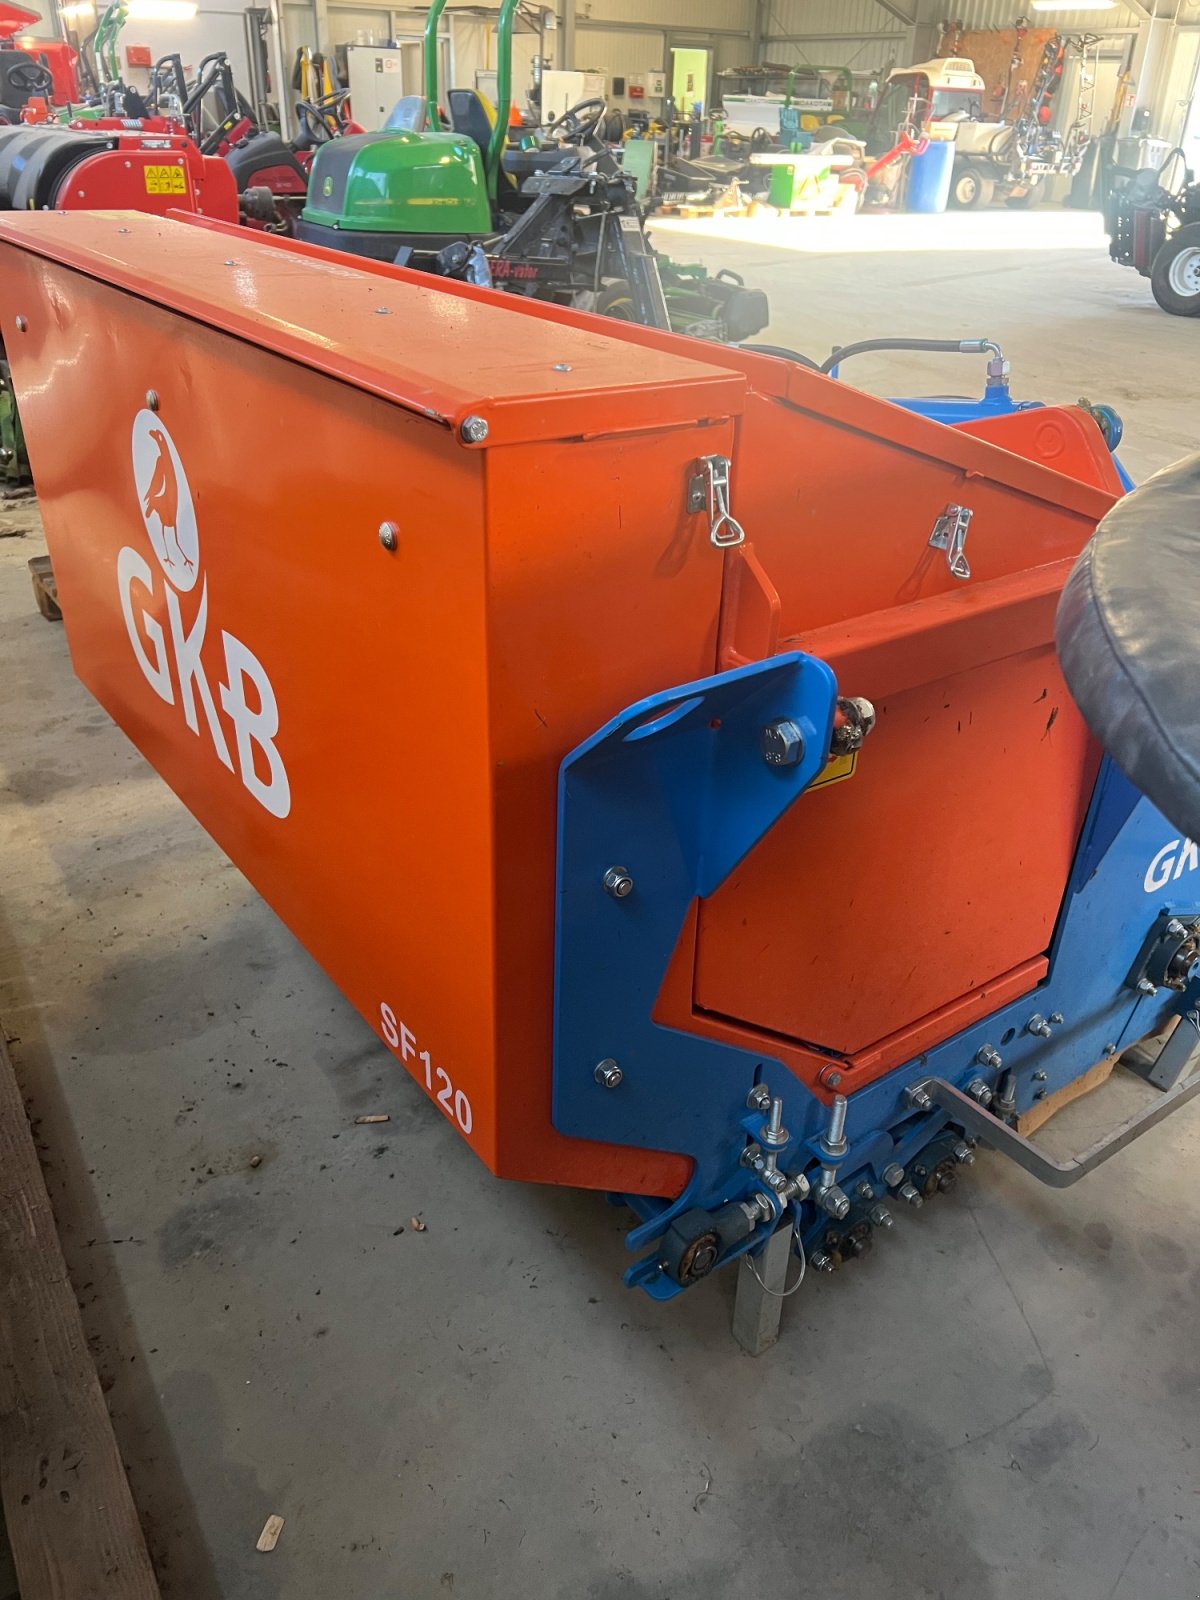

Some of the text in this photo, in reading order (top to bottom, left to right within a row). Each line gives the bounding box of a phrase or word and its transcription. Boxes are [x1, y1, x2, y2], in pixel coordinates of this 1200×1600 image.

[491, 260, 538, 279] ERA-vator
[117, 547, 291, 819] GKB
[1144, 838, 1199, 892] GK
[380, 1002, 472, 1133] SF120
